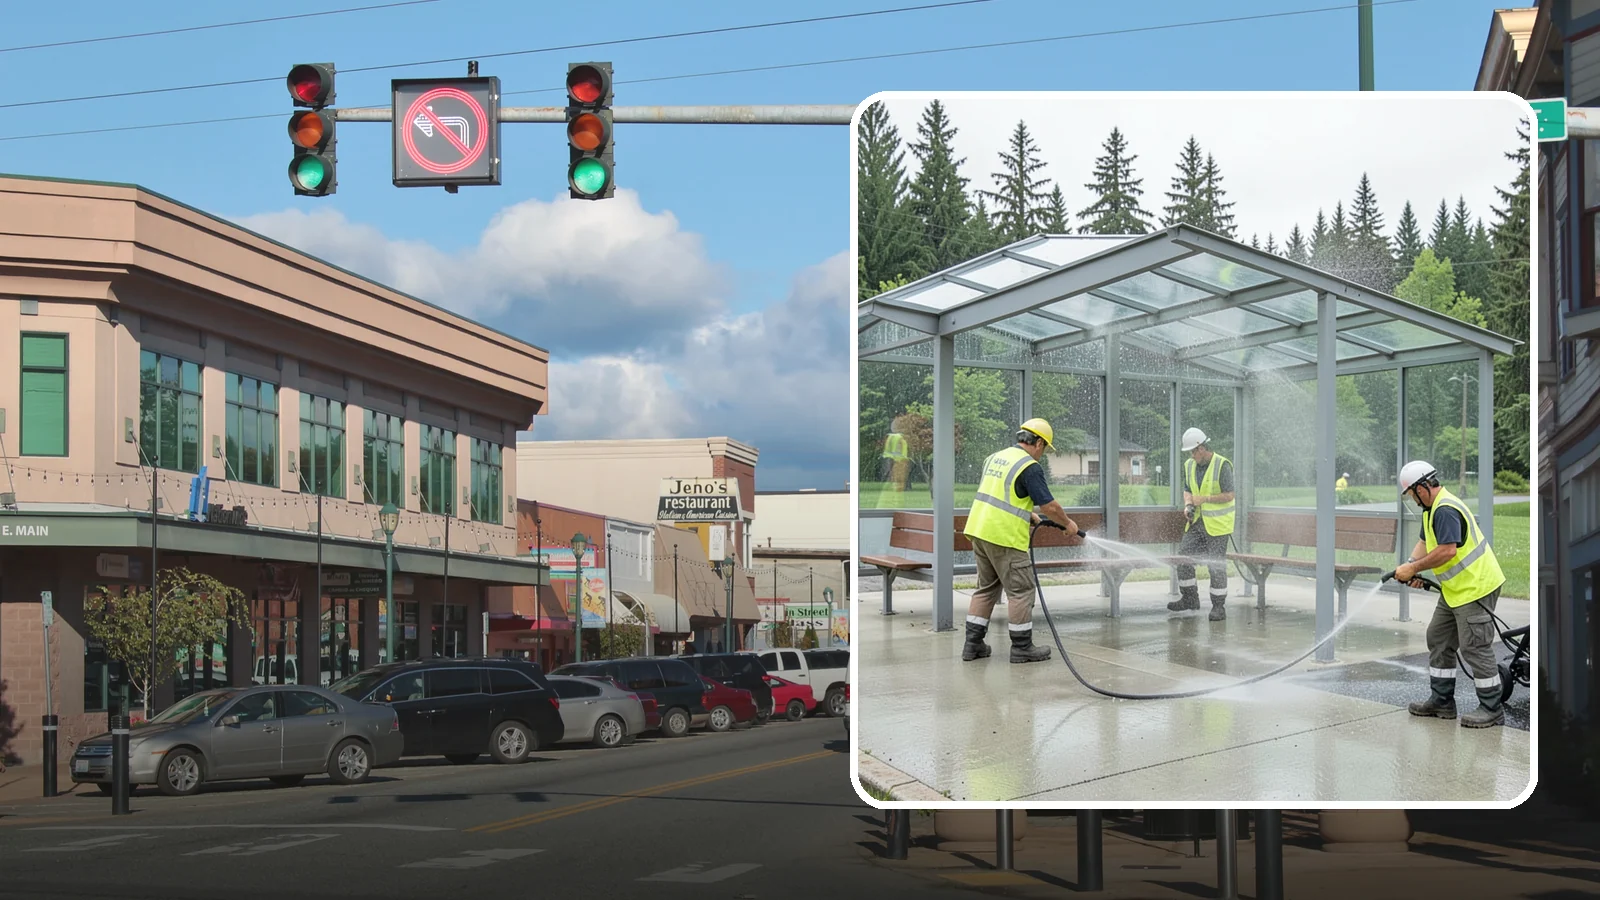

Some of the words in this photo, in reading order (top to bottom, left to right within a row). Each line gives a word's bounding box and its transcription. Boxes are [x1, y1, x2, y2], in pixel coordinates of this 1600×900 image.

[670, 480, 727, 494] Jeno's
[665, 497, 731, 509] restaurant
[686, 509, 714, 519] American
[715, 509, 737, 519] Cuisine
[2, 525, 13, 536] E.
[15, 525, 49, 536] MAIN
[797, 608, 829, 617] Street
